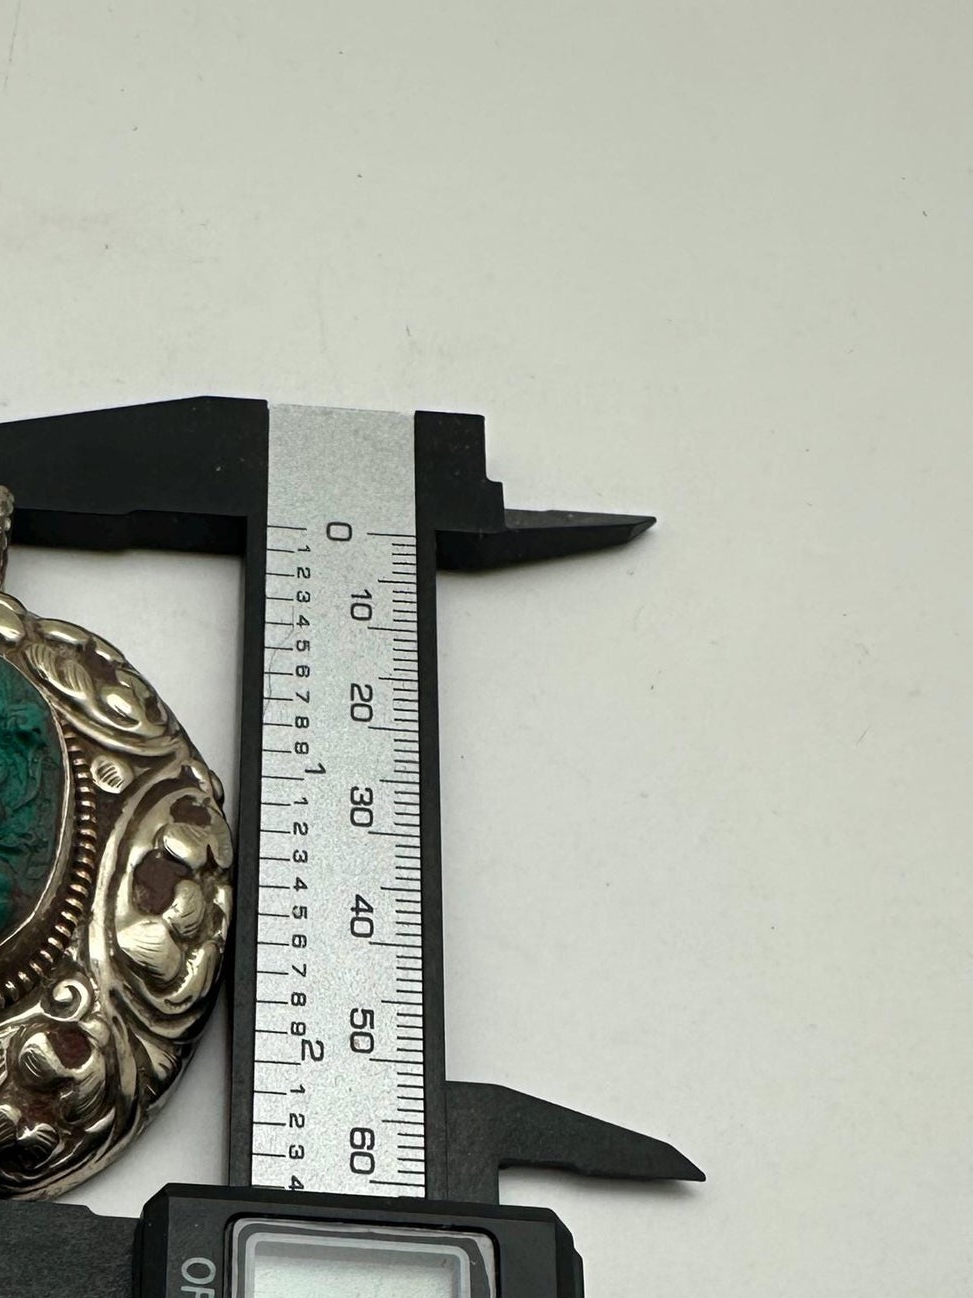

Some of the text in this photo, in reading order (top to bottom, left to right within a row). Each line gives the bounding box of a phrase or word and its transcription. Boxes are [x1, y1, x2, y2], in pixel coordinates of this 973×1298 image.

[326, 521, 353, 542] 0
[296, 544, 312, 553] 1
[296, 566, 312, 580] 2
[295, 589, 312, 604] 3
[350, 588, 373, 622] 10
[295, 614, 311, 629] 4
[294, 639, 311, 653] 5
[294, 664, 311, 679] 6
[294, 690, 311, 704] 7
[349, 682, 374, 723] 20
[294, 715, 310, 730] 8
[304, 762, 327, 775] 1
[293, 796, 309, 806] 1
[349, 785, 374, 828] 30
[292, 821, 309, 837] 2
[292, 848, 309, 864] 3
[292, 876, 309, 893] 4
[291, 904, 308, 920] 5
[349, 893, 375, 939] 40
[291, 933, 308, 949] 6
[291, 963, 307, 978] 7
[290, 991, 307, 1007] 8
[290, 1020, 307, 1037] 9
[349, 1007, 375, 1055] 50
[300, 1038, 325, 1063] 2
[289, 1083, 306, 1094] 1
[288, 1112, 306, 1129] 2
[288, 1144, 305, 1160] 3
[349, 1126, 376, 1176] 60
[288, 1175, 305, 1191] 4
